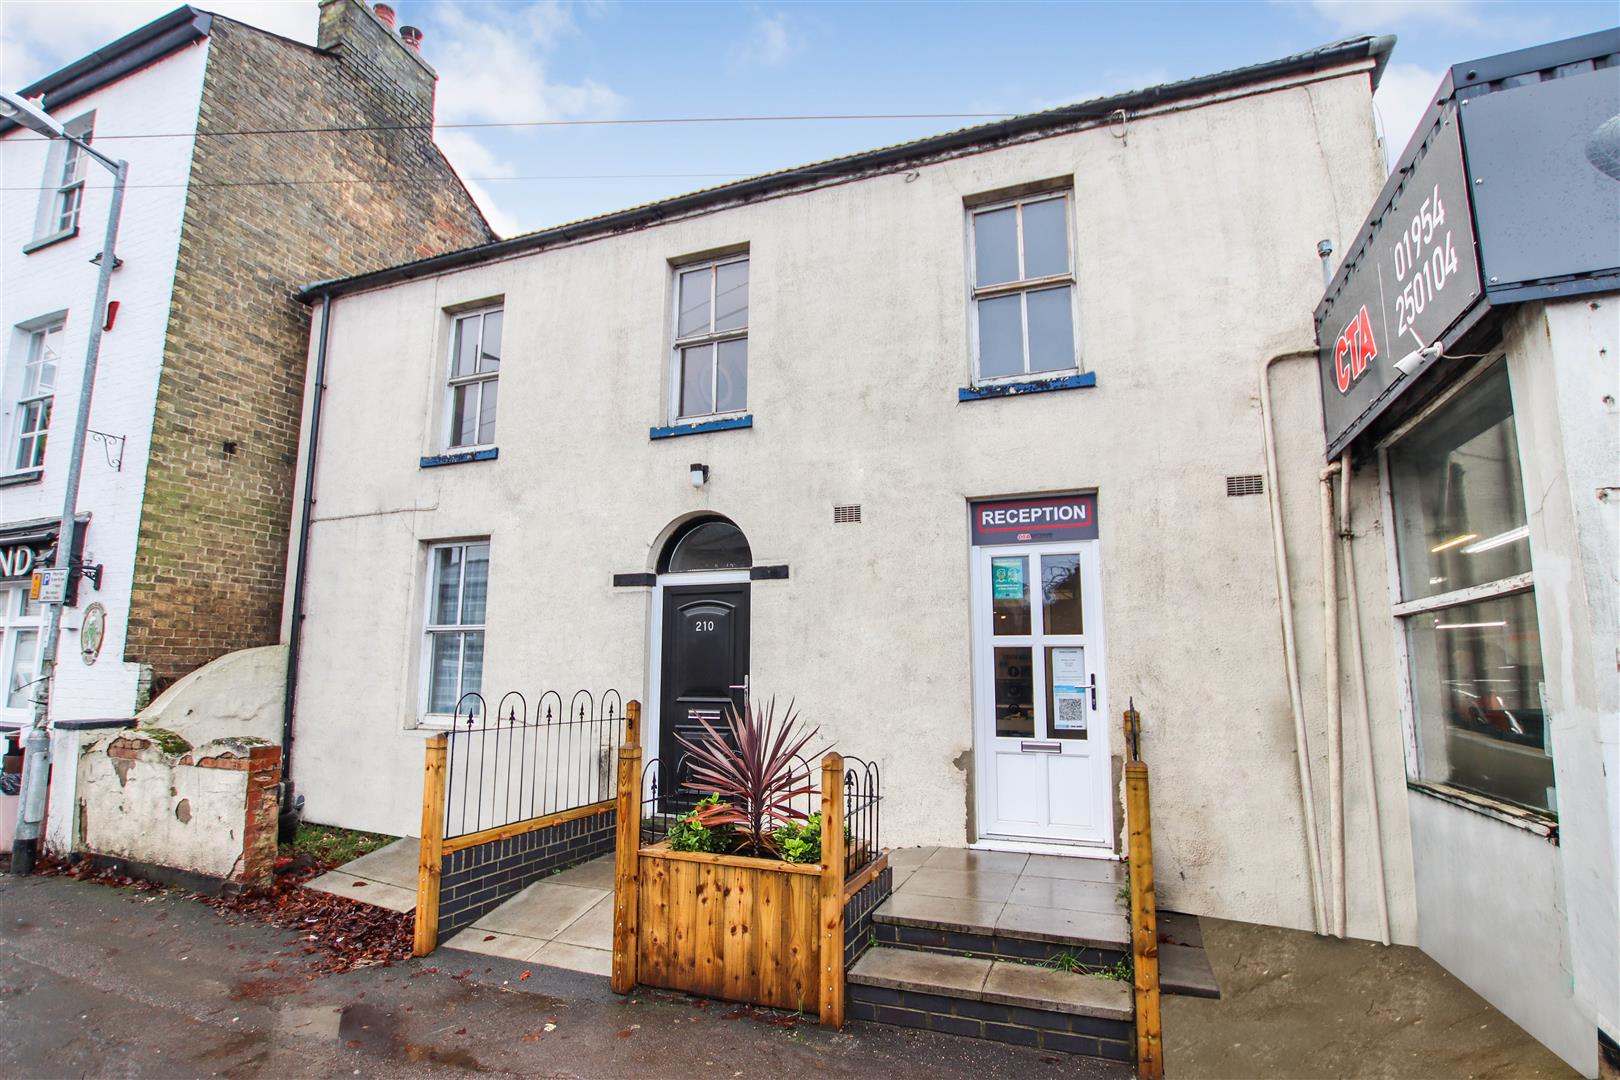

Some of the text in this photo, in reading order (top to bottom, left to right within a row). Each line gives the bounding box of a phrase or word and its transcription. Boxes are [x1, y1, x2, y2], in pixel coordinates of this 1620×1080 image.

[1394, 184, 1445, 282] 01954
[1395, 230, 1459, 338] 250104
[1335, 304, 1378, 393] CTA
[982, 504, 1086, 526] RECEPTION
[695, 621, 714, 632] 210
